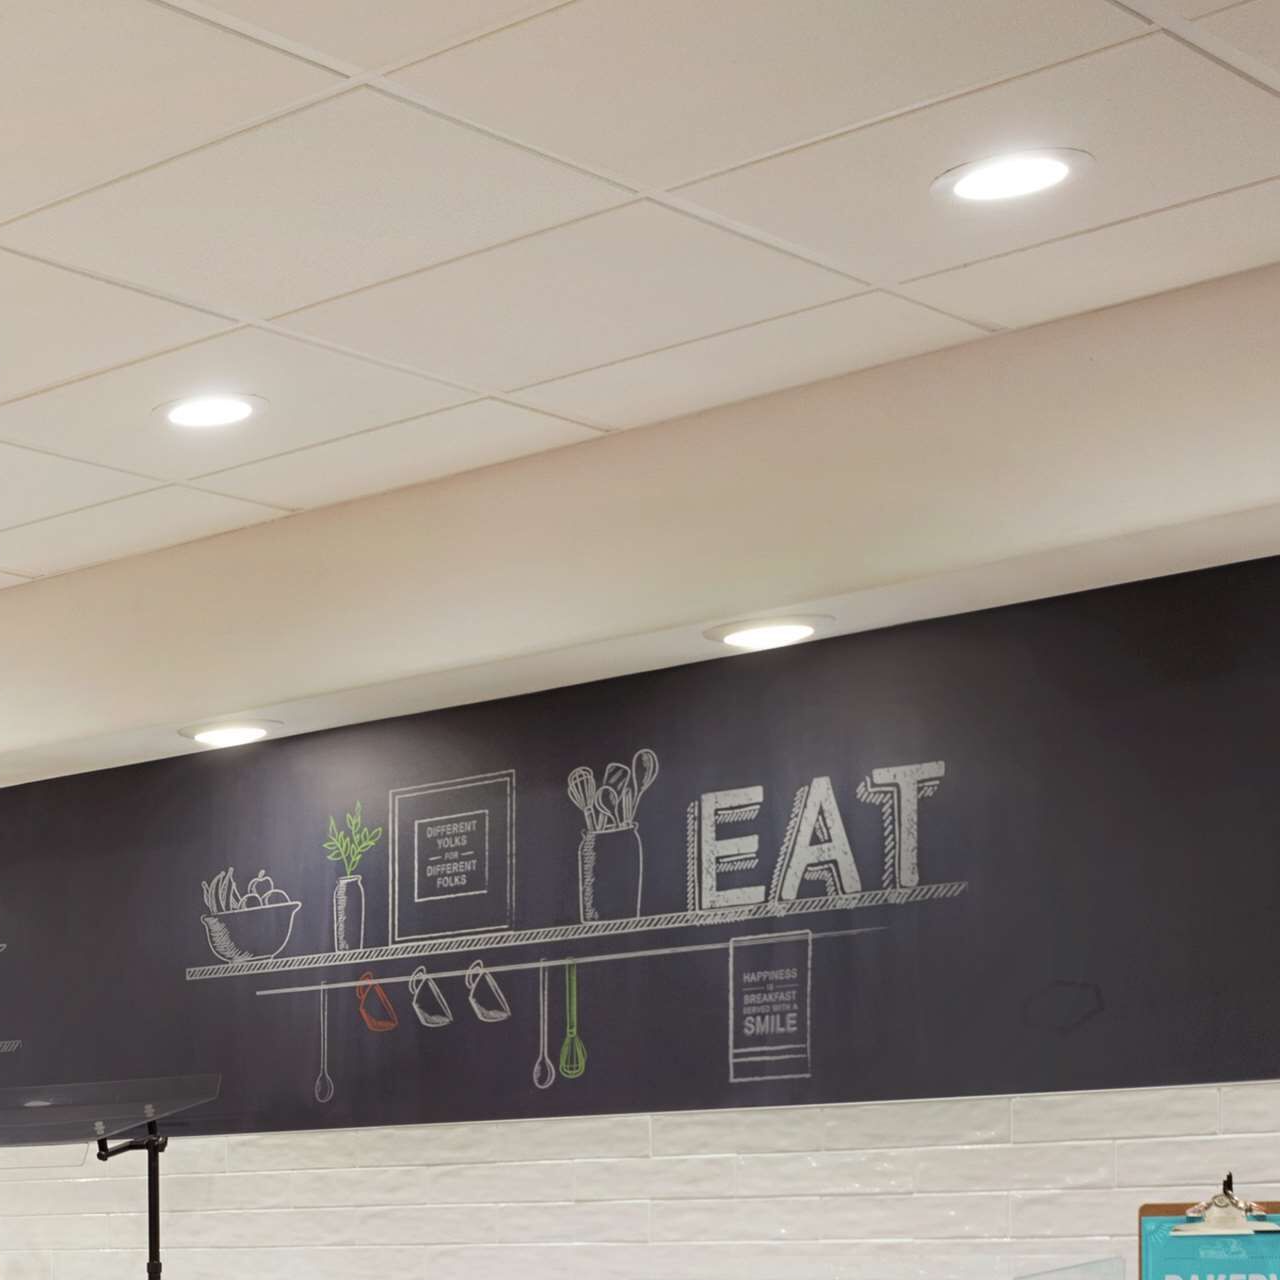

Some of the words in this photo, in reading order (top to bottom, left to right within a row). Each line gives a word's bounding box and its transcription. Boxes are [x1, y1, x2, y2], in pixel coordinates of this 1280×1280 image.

[426, 820, 477, 838] DIFFERENT
[689, 761, 945, 911] EAT
[437, 835, 467, 849] YOLKS
[426, 860, 477, 877] DIFFERENT
[436, 874, 467, 888] FOLKS
[743, 968, 798, 983] HAPPINESS
[744, 990, 797, 1005] BREAKFAST
[744, 1012, 797, 1036] SMILE
